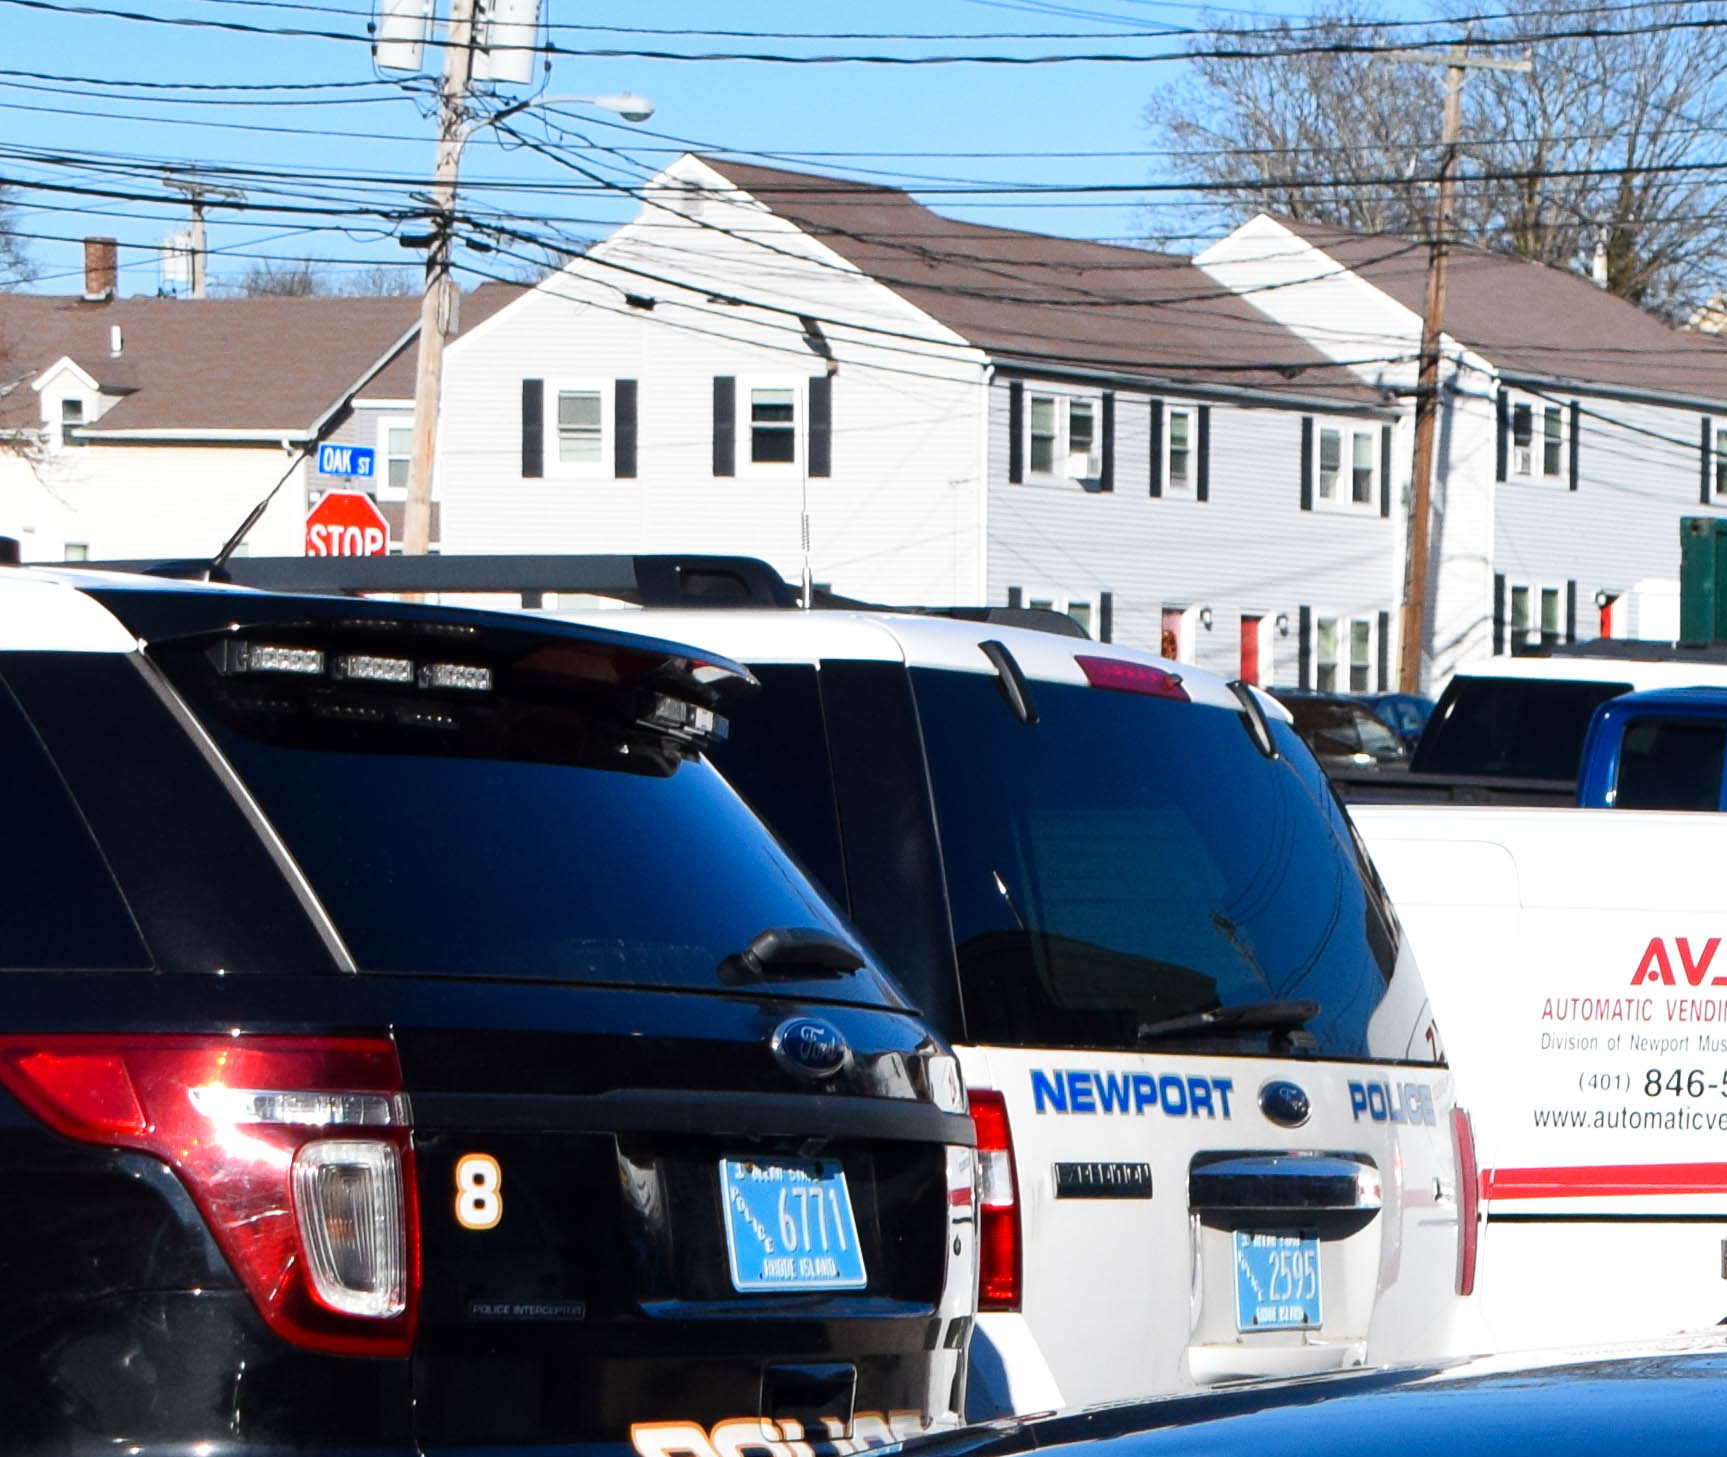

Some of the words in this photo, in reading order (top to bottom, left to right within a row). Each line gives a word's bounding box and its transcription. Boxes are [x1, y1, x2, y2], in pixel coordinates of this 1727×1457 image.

[323, 447, 352, 473] OAK
[358, 456, 371, 475] ST
[308, 523, 384, 556] STOP
[1542, 998, 1653, 1022] AUTOMATIC
[1541, 1032, 1598, 1051] Division
[1608, 1033, 1621, 1051] of
[1630, 1034, 1689, 1056] Newport
[1029, 1068, 1235, 1121] NEWPORT
[1347, 1078, 1438, 1126] POLICE
[1578, 1072, 1631, 1093] (401)
[455, 1152, 503, 1230] 8
[731, 1186, 774, 1254] POLICE
[778, 1187, 847, 1253] 6771
[1268, 1250, 1316, 1301] 2595
